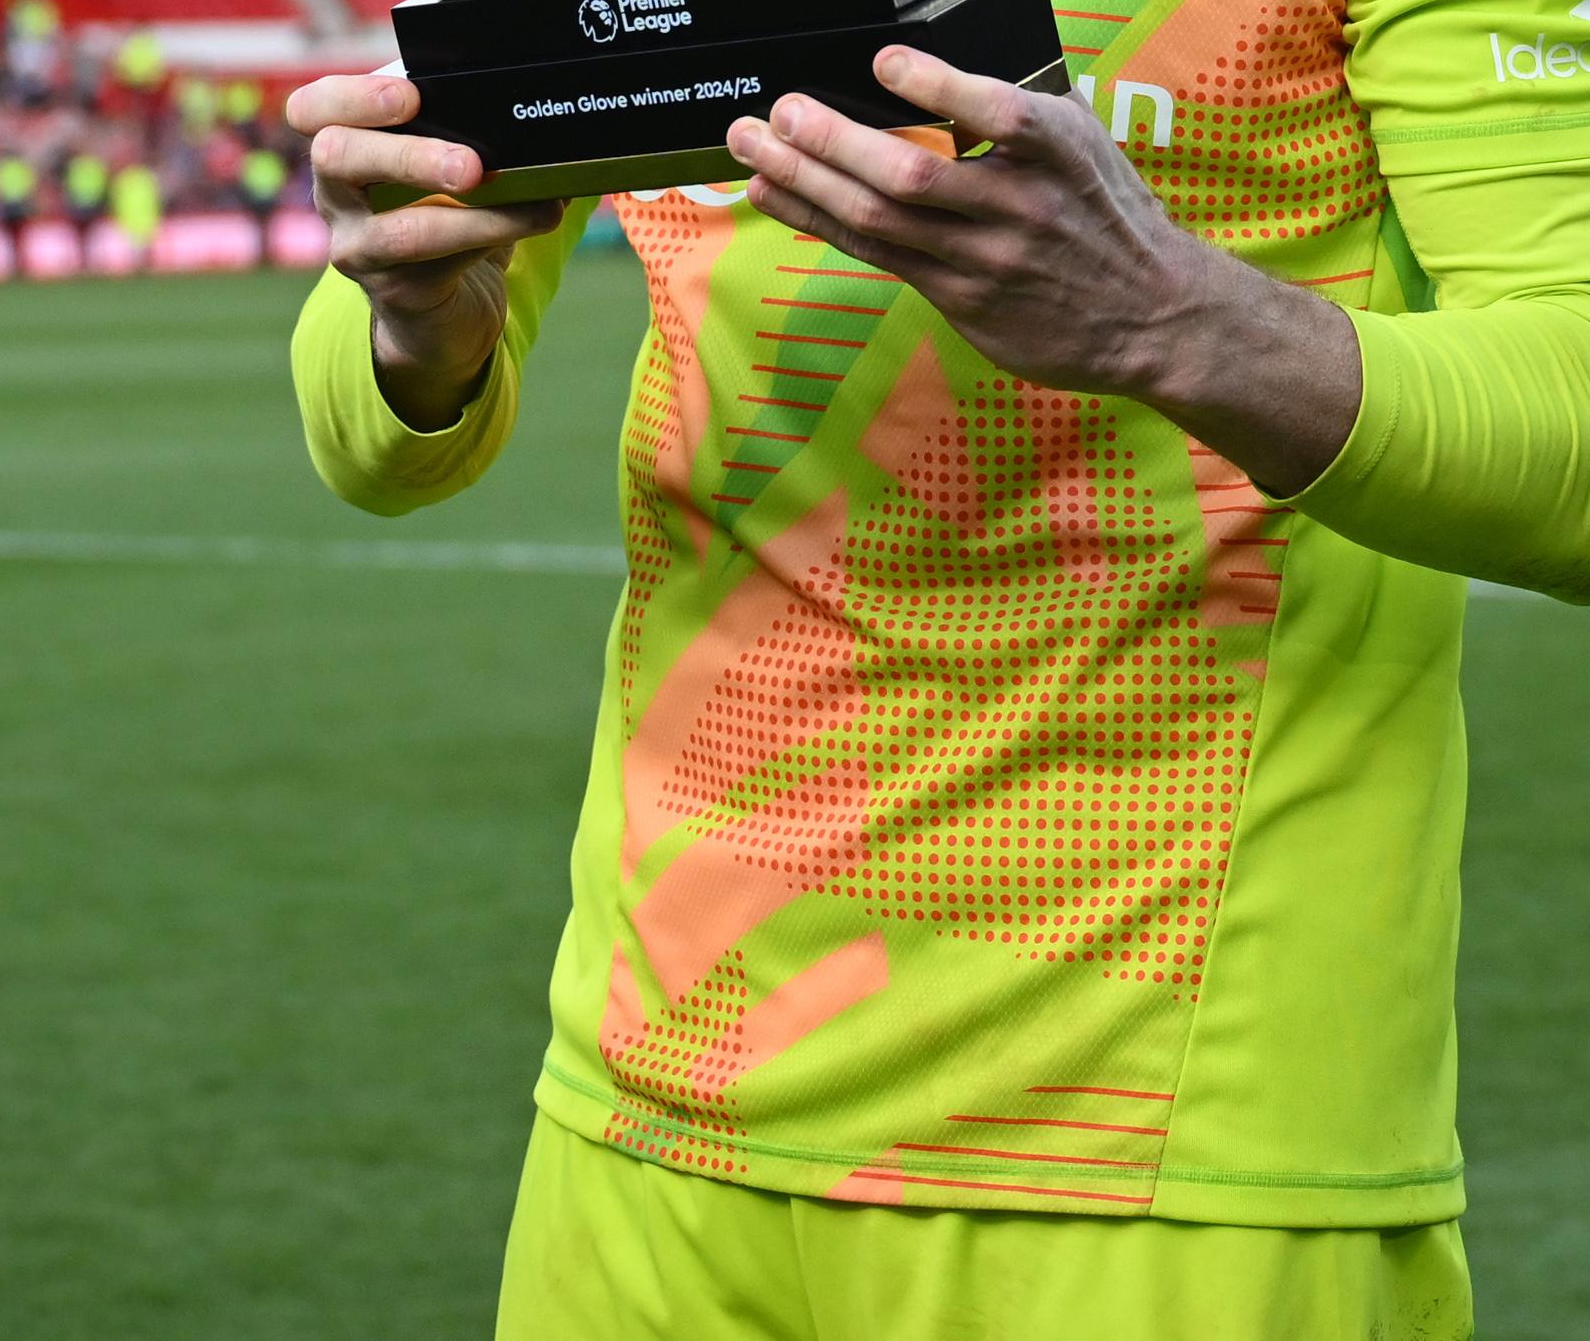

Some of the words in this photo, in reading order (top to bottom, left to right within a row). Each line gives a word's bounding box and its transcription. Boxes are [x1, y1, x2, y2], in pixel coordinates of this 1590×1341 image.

[621, 10, 692, 33] League
[513, 99, 575, 119] Golden
[578, 93, 628, 113] Glove
[630, 87, 691, 106] winner
[694, 77, 761, 100] 2024/25
